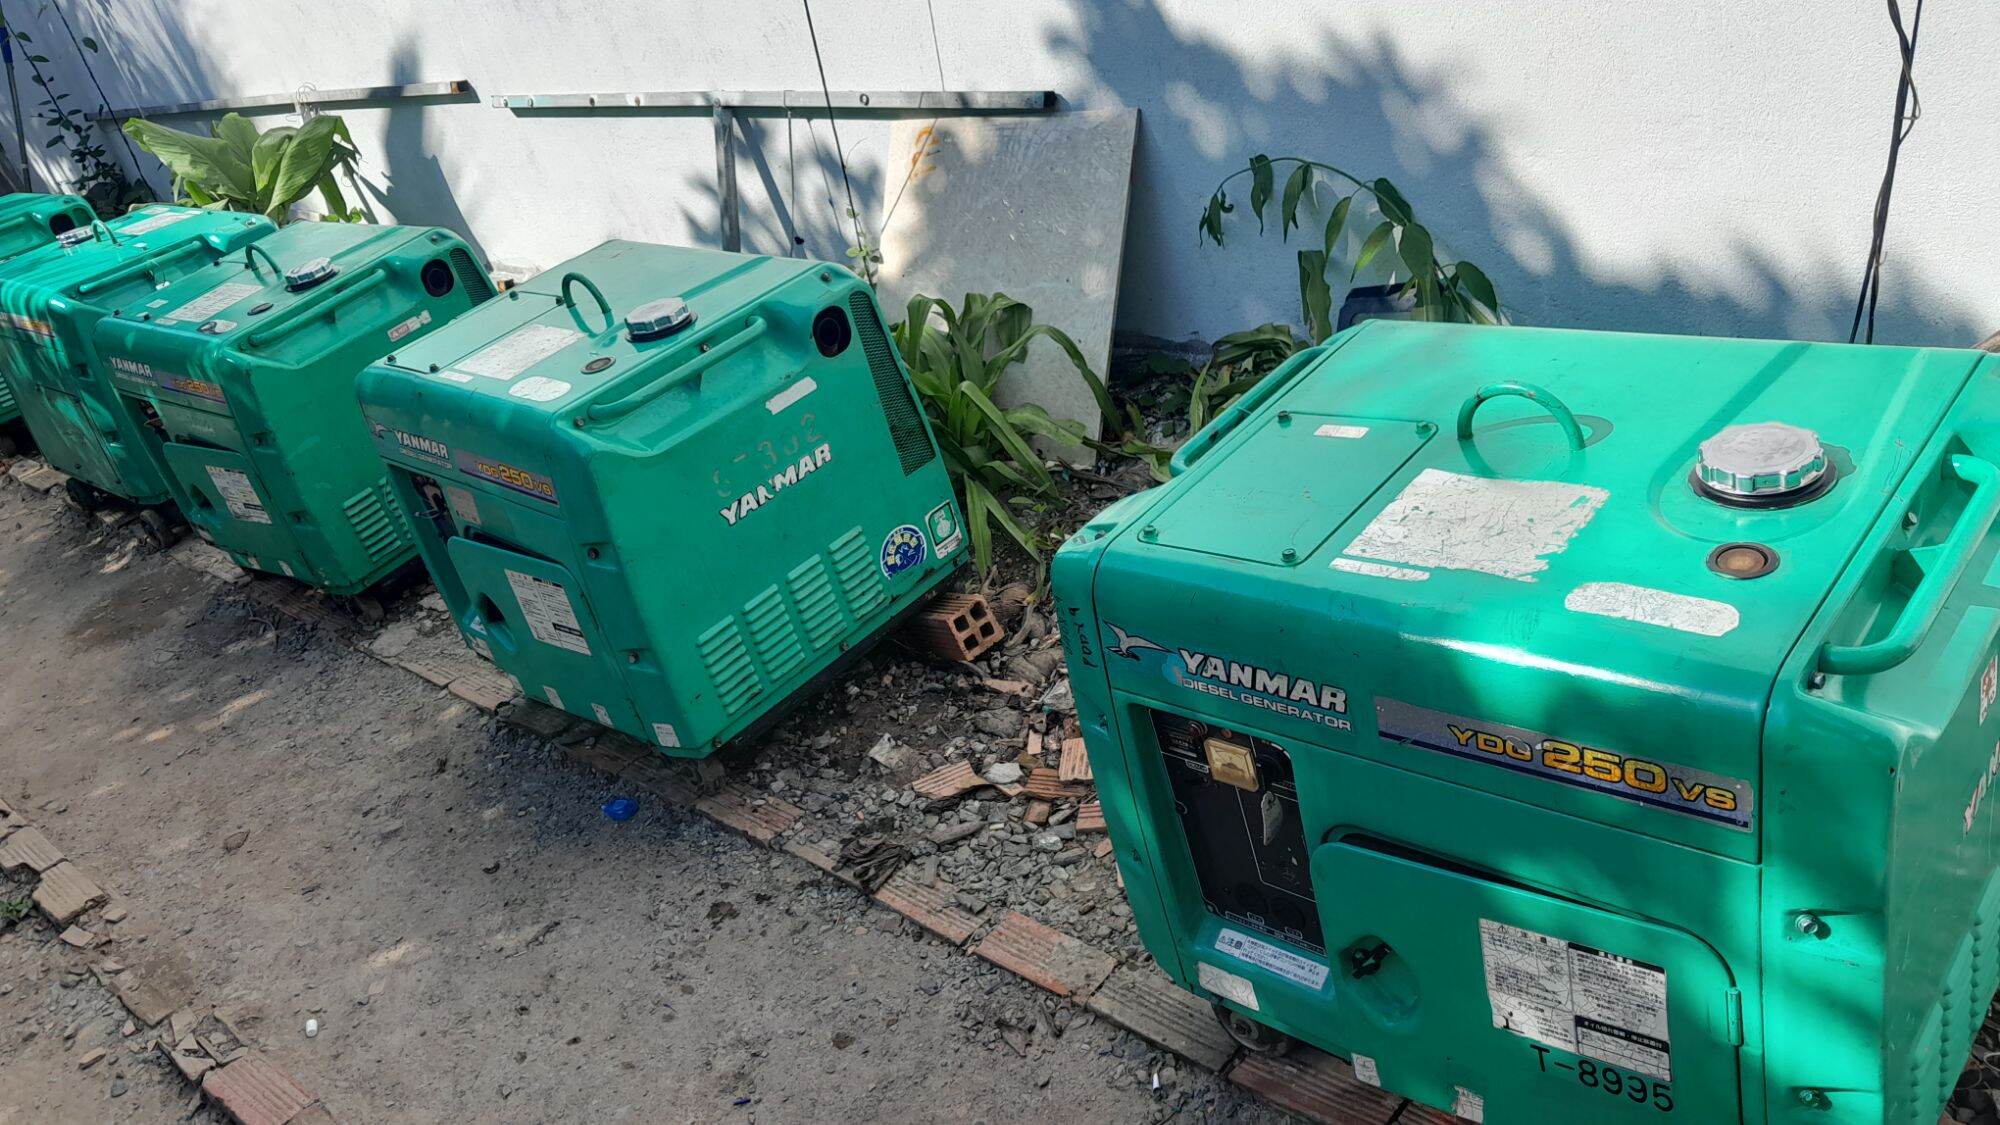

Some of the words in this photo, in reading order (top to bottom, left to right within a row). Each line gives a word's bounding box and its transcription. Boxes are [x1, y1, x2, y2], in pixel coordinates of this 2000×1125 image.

[109, 356, 153, 378] YANMAR
[394, 429, 449, 459] YANMAR
[499, 463, 535, 492] 250
[719, 443, 832, 526] YANMAR
[1178, 648, 1347, 714] YANMAR
[1182, 679, 1239, 701] DIESEL
[1240, 693, 1352, 731] GENERATOR
[1539, 738, 1668, 795] 250
[1671, 776, 1737, 812] VS
